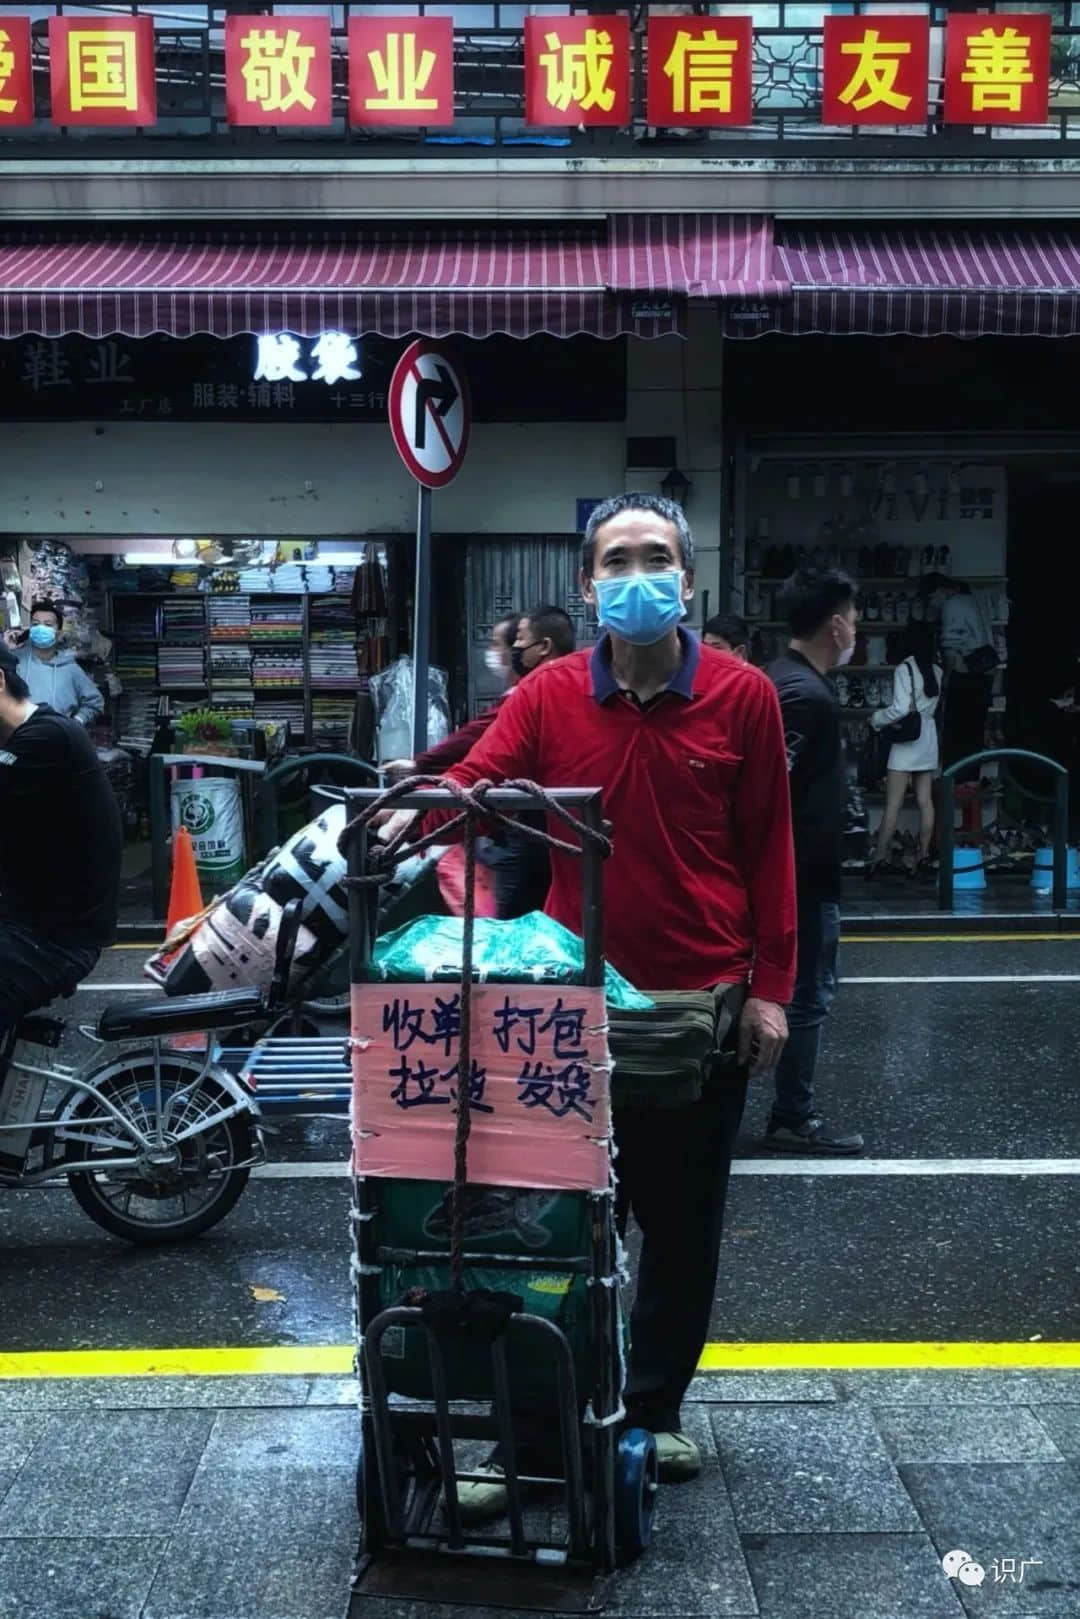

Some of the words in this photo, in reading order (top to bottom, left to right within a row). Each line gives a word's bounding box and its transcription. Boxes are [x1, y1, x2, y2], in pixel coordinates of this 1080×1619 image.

[0, 30, 138, 113] 国
[240, 29, 438, 113] 敬业
[539, 29, 738, 113] 诚信
[838, 28, 1034, 112] 友善
[20, 340, 135, 391] 鞋业
[328, 391, 385, 409] 十三行
[383, 994, 461, 1056] 收单
[493, 995, 588, 1059] 打包
[517, 1061, 598, 1122] 发货
